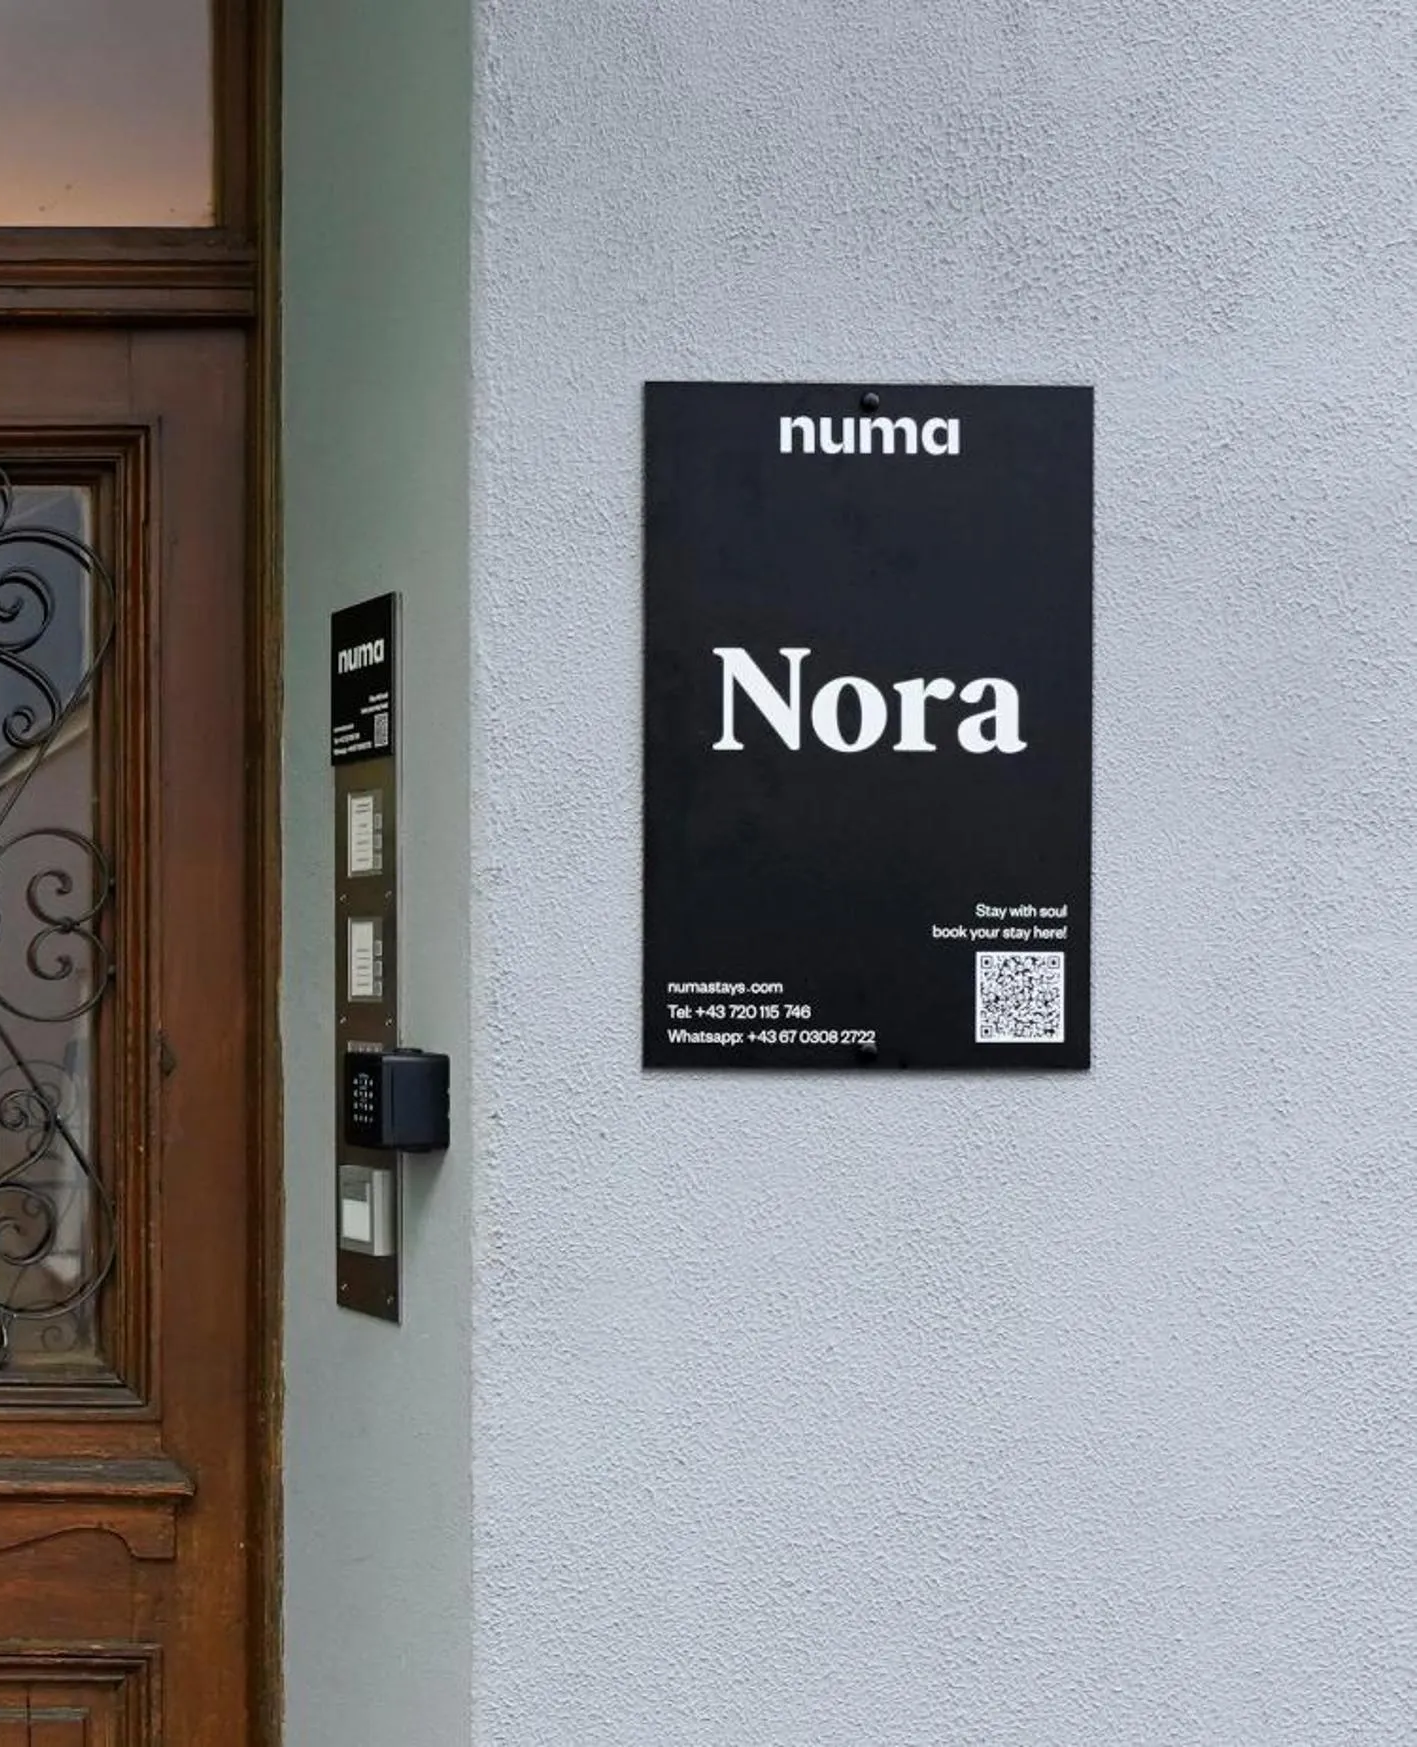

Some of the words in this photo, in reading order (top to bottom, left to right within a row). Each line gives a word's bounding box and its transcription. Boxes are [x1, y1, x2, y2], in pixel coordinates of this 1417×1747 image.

[779, 415, 960, 456] numa
[338, 638, 385, 674] numa
[712, 647, 1028, 754] Nora
[975, 903, 1008, 920] Stay
[1008, 904, 1038, 918] with
[1039, 904, 1068, 918] soul
[932, 924, 968, 939] book
[969, 927, 1001, 941] your
[1002, 926, 1032, 941] stay
[1033, 925, 1068, 940] here!
[667, 981, 784, 996] numastays.com
[667, 1004, 693, 1019] Tel:
[695, 1004, 726, 1019] +43
[728, 1004, 758, 1019] 720
[759, 1004, 780, 1019] 115
[783, 1004, 812, 1019] 746
[667, 1028, 744, 1046] Whatsapp:
[747, 1029, 778, 1044] +43
[778, 1029, 798, 1044] 67
[798, 1029, 839, 1044] 0308
[840, 1029, 876, 1044] 2722
